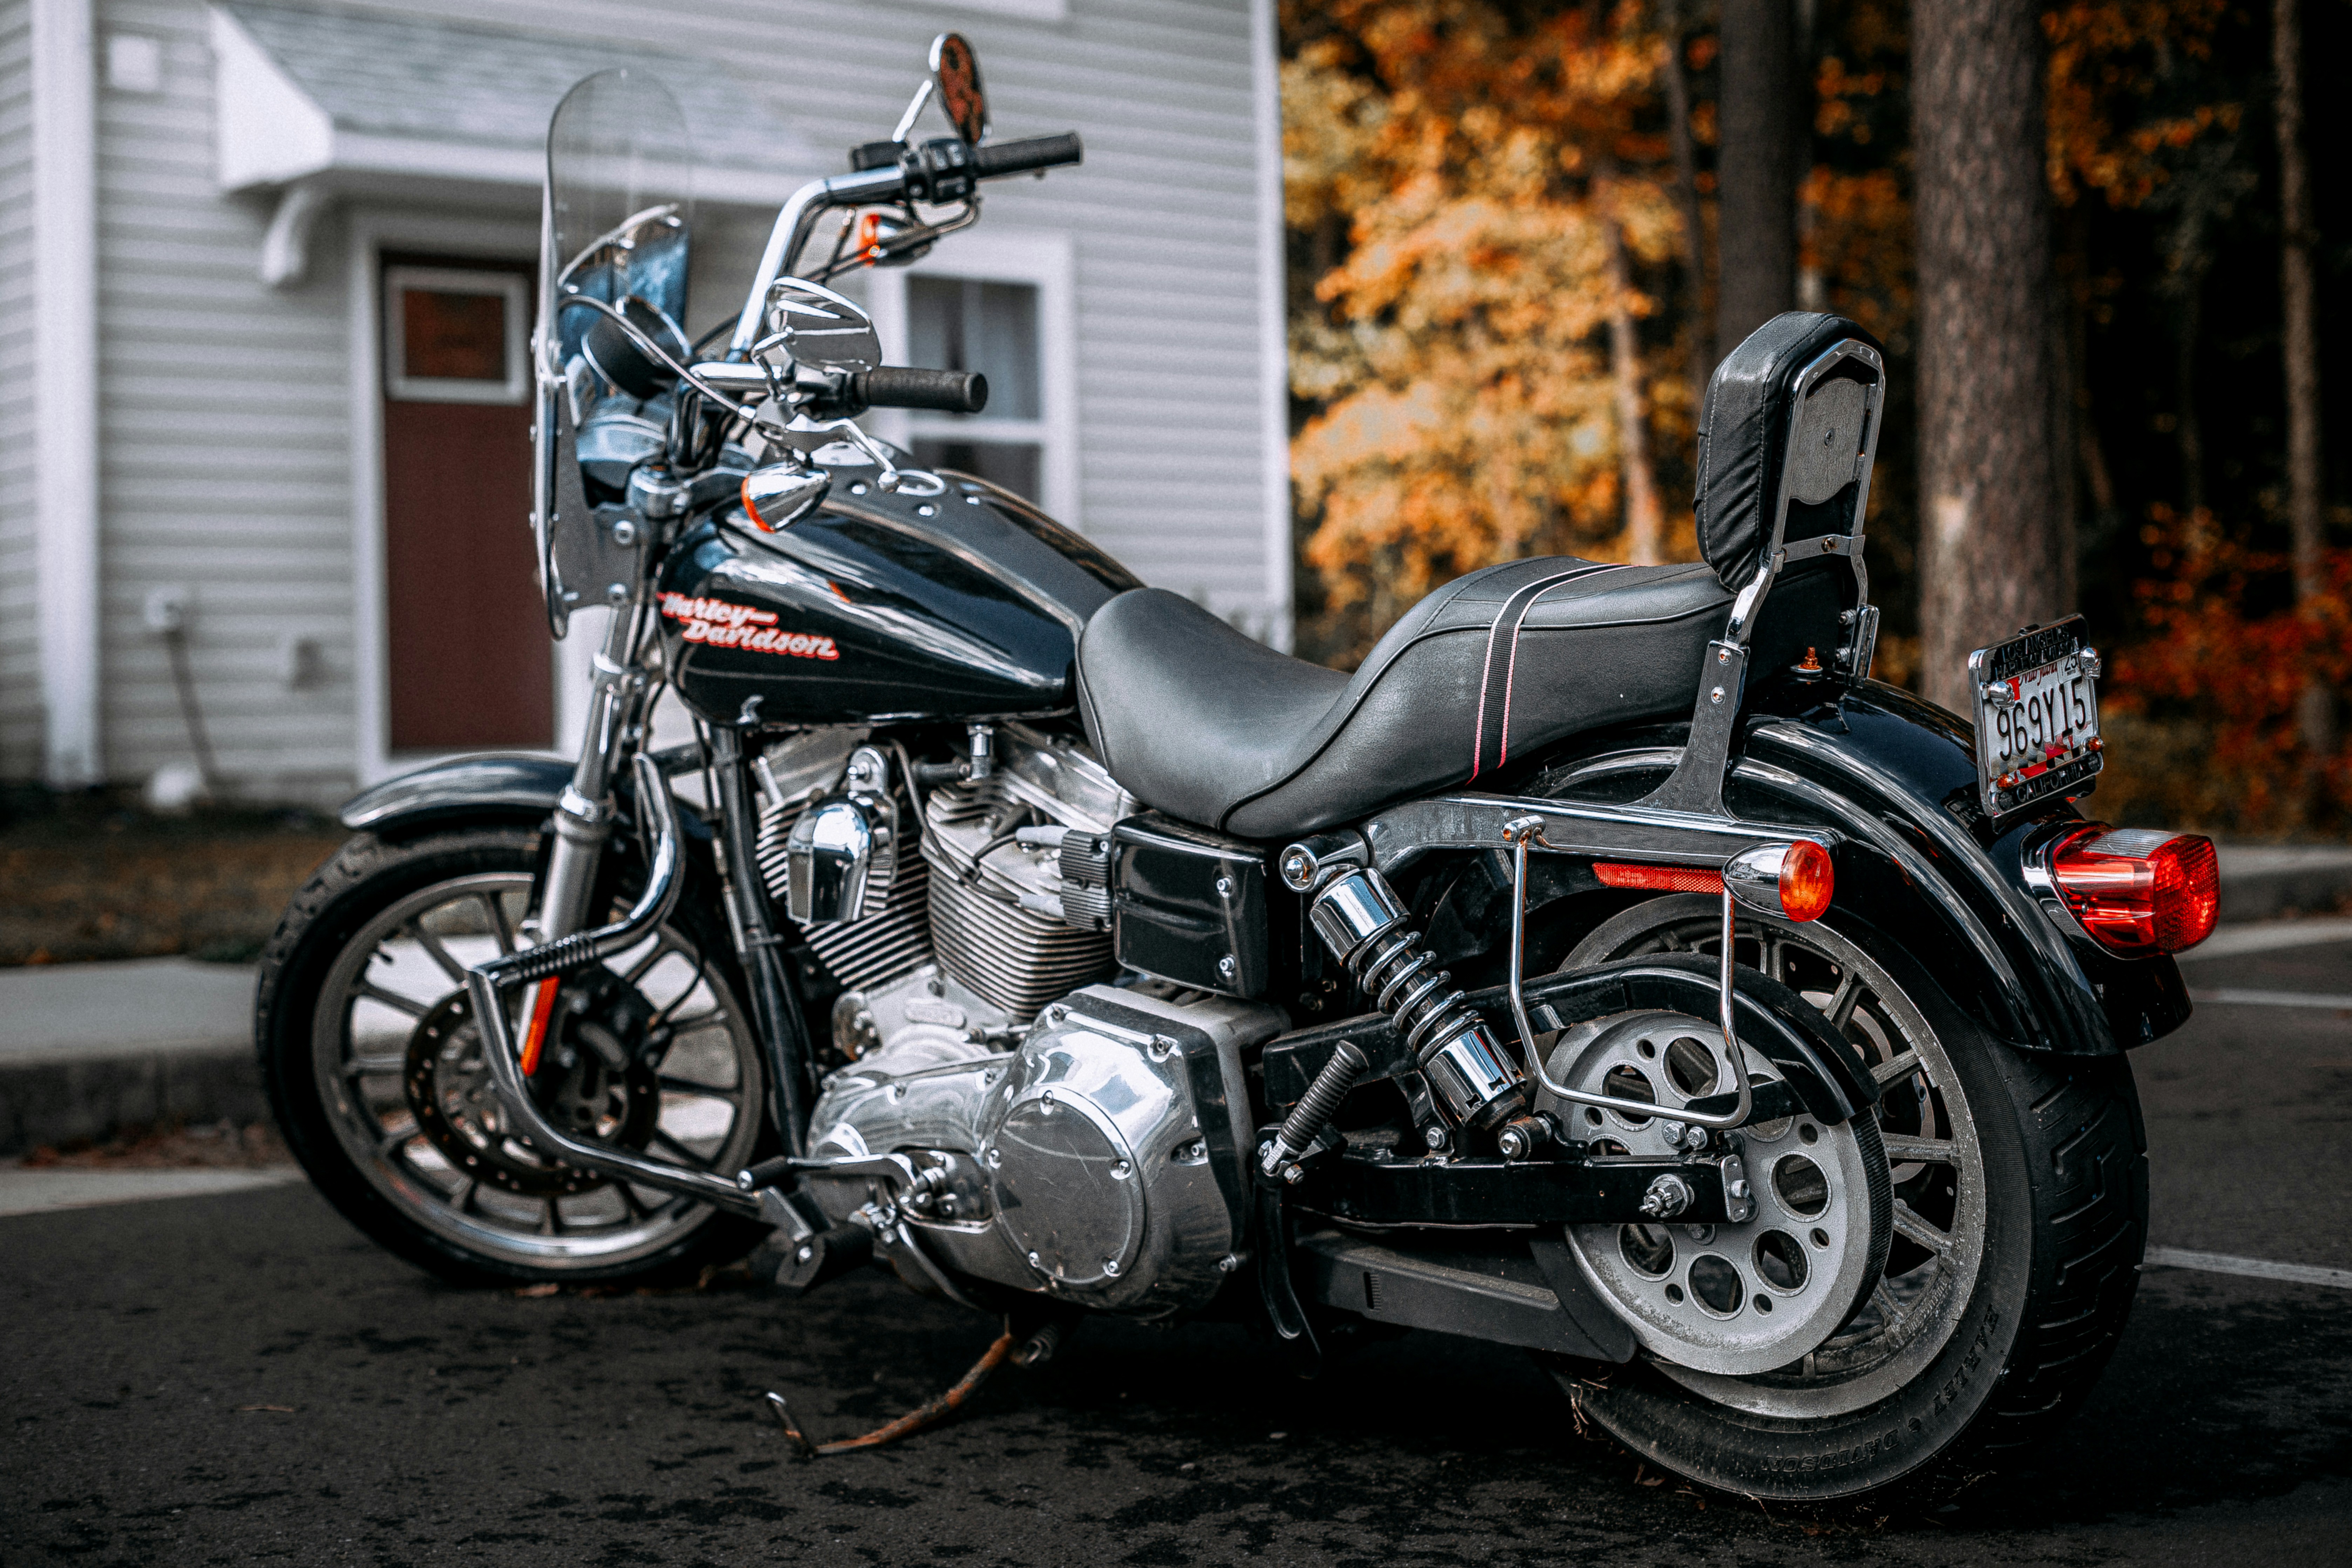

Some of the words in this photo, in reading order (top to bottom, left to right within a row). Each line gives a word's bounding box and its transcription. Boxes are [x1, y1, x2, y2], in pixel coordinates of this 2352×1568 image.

[680, 619, 839, 660] Davidson
[1995, 637, 2080, 680] HARLEY-DAVIDSON
[2001, 641, 2023, 663] LOS
[2026, 624, 2069, 654] ANGELES
[1997, 676, 2086, 761] 969Y15
[2016, 762, 2086, 802] CALIFORNIA
[1933, 1303, 1998, 1418] HARLEY
[1762, 1429, 1899, 1472] DAVIDSON
